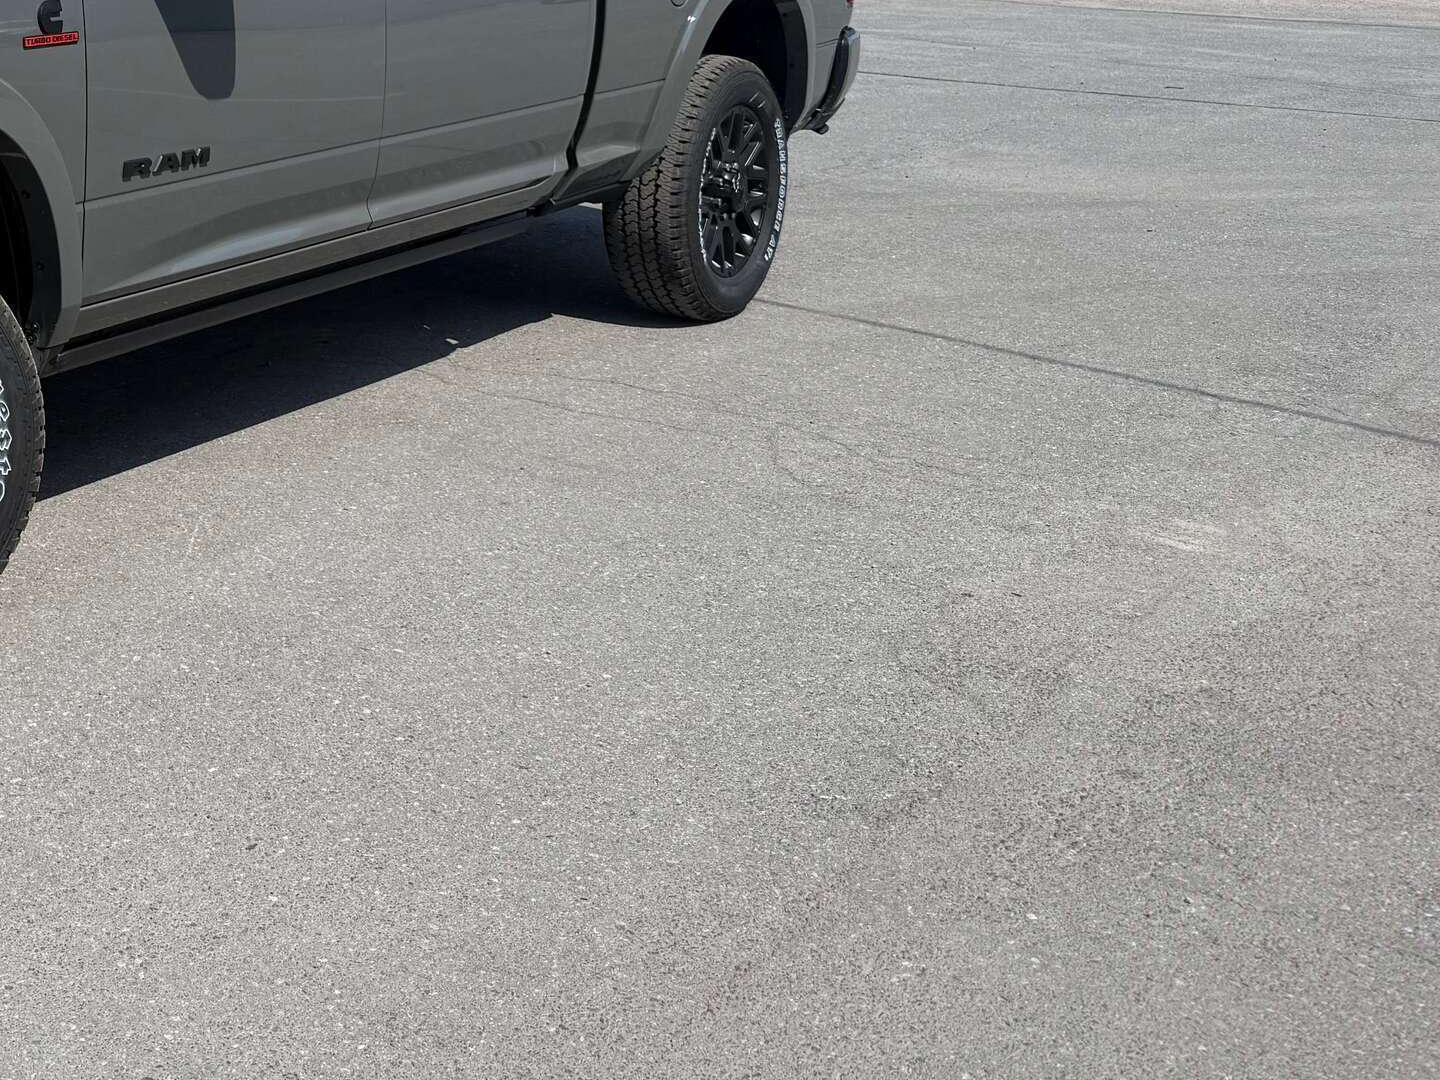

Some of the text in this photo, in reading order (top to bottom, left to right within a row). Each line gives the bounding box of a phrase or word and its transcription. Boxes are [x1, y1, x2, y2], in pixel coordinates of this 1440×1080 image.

[26, 33, 77, 46] TURBO DIESEL
[122, 146, 211, 183] RAM
